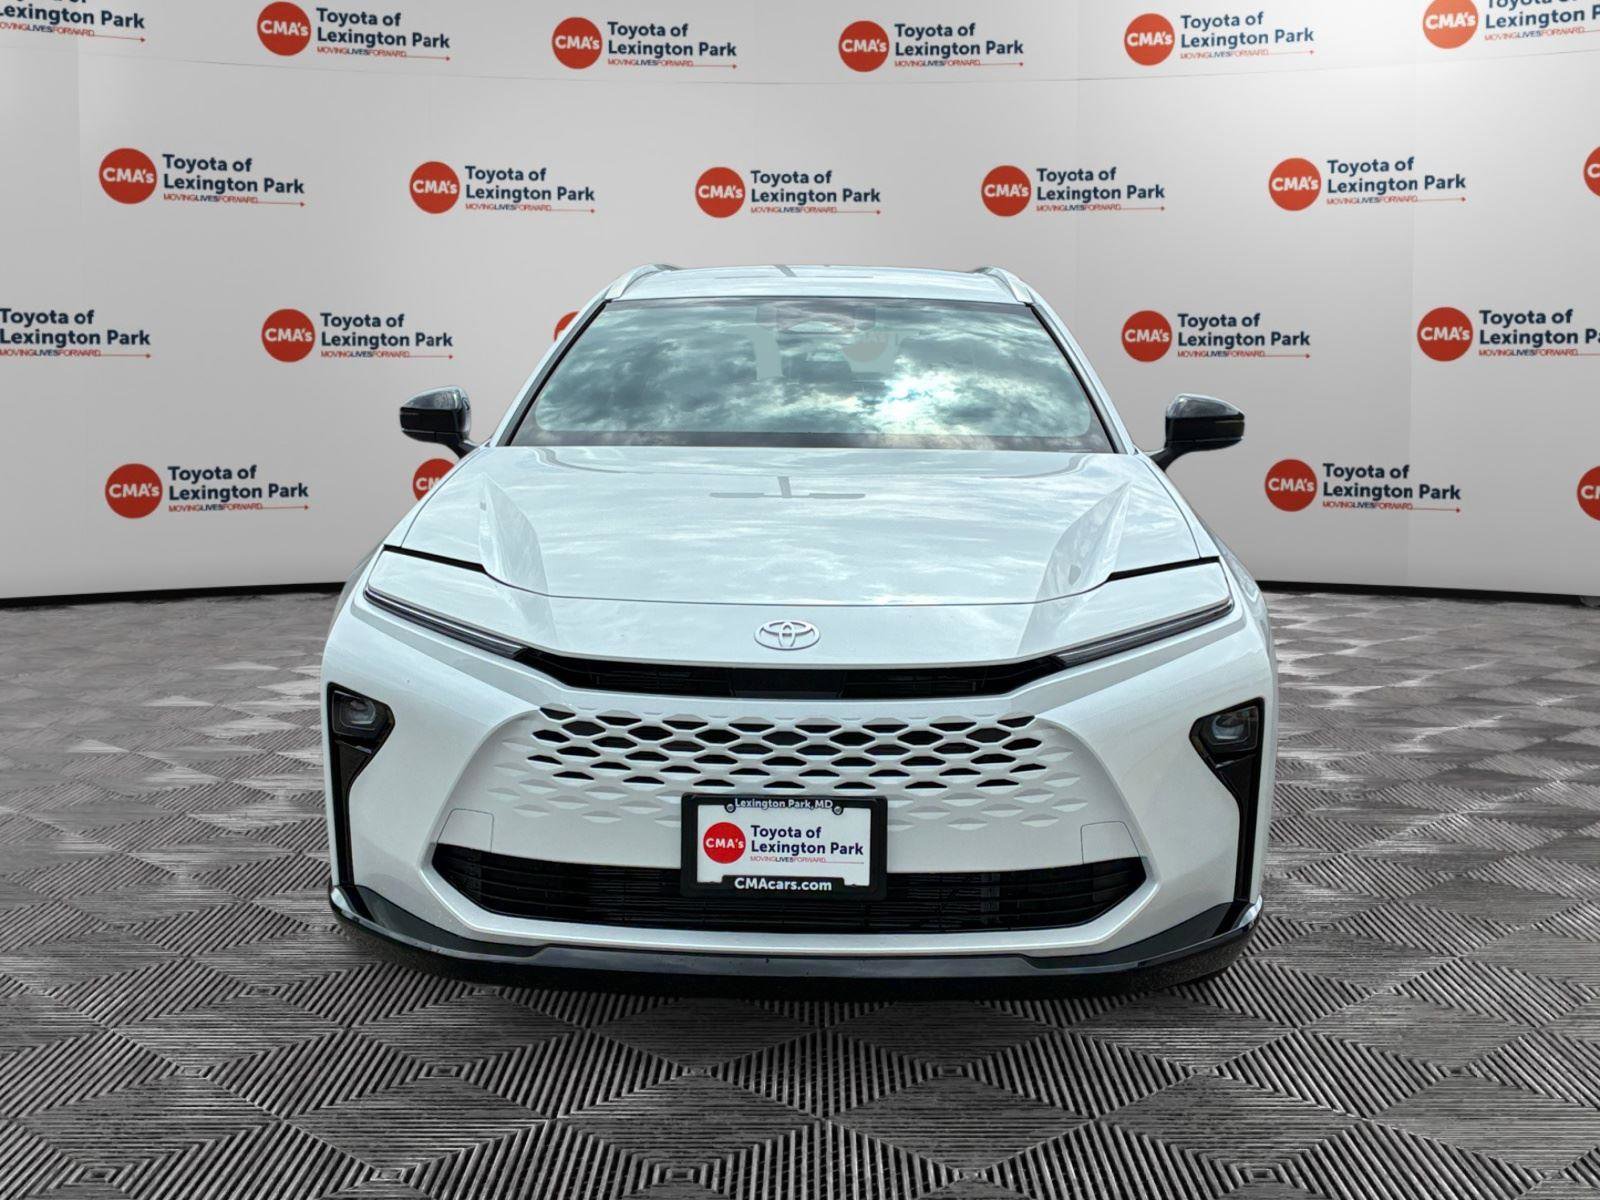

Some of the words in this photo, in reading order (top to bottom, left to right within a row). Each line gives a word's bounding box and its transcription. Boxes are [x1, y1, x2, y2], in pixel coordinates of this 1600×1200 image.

[101, 10, 145, 29] Park
[316, 7, 378, 27] Toyota
[383, 13, 402, 26] of
[1180, 14, 1240, 32] Toyota
[1245, 11, 1264, 26] of
[1425, 11, 1477, 30] CMA's
[1485, 9, 1585, 29] Lexington
[260, 19, 309, 37] CMA's
[607, 21, 666, 40] Toyota
[671, 23, 689, 37] of
[894, 23, 953, 42] Toyota
[958, 22, 976, 36] of
[317, 27, 407, 48] Lexington
[412, 32, 451, 49] Park
[554, 35, 600, 50] CMA's
[841, 38, 887, 53] CMA's
[1126, 30, 1173, 47] CMA's
[1181, 32, 1269, 49] Lexington
[1274, 28, 1315, 43] Park
[608, 40, 694, 59] Lexington
[699, 42, 737, 57] Park
[895, 42, 981, 60] Lexington
[986, 40, 1024, 55] Park
[162, 153, 228, 174] Toyota
[233, 157, 253, 173] of
[1327, 158, 1390, 177] Toyota
[1395, 156, 1415, 172] of
[102, 167, 155, 184] CMA's
[163, 174, 258, 194] Lexington
[263, 178, 305, 194] Park
[464, 165, 524, 185] Toyota
[529, 168, 547, 182] of
[750, 169, 810, 188] Toyota
[814, 170, 833, 184] of
[1036, 167, 1094, 186] Toyota
[1098, 166, 1117, 181] of
[1271, 175, 1320, 192] CMA's
[1327, 177, 1418, 196] Lexington
[1424, 173, 1466, 190] Park
[412, 179, 458, 195] CMA's
[465, 185, 552, 203] Lexington
[557, 187, 595, 201] Park
[698, 184, 744, 199] CMA's
[983, 183, 1030, 198] CMA's
[1037, 186, 1122, 203] Lexington
[1126, 184, 1165, 199] Park
[751, 188, 837, 206] Lexington
[842, 189, 881, 203] Park
[0, 308, 69, 328] Toyota
[74, 309, 95, 325] of
[319, 312, 382, 332] Toyota
[386, 313, 405, 328] of
[1177, 313, 1237, 331] Toyota
[1242, 312, 1261, 328] of
[1478, 309, 1547, 329] Toyota
[1551, 308, 1574, 325] of
[0, 328, 101, 349] Lexington
[106, 329, 151, 346] Park
[264, 327, 313, 343] CMA's
[321, 332, 410, 351] Lexington
[415, 332, 453, 347] Park
[1124, 328, 1170, 344] CMA's
[1177, 331, 1266, 350] Lexington
[1270, 330, 1311, 346] Park
[1420, 326, 1470, 341] CMA's
[1479, 329, 1579, 349] Lexington
[167, 465, 233, 485] Toyota
[237, 464, 258, 480] of
[1322, 462, 1386, 482] Toyota
[1390, 464, 1410, 480] of
[108, 483, 160, 498] CMA's
[168, 484, 263, 503] Lexington
[268, 483, 309, 499] Park
[1267, 477, 1315, 492] CMA's
[1322, 482, 1414, 501] Lexington
[1418, 484, 1462, 500] Park
[735, 798, 786, 810] Lexington
[750, 825, 801, 840] Toyota
[805, 826, 822, 839] of
[705, 838, 745, 849] CMA's
[751, 841, 826, 856] Lexington
[830, 843, 864, 856] Park
[734, 877, 832, 891] CMAcars.com
